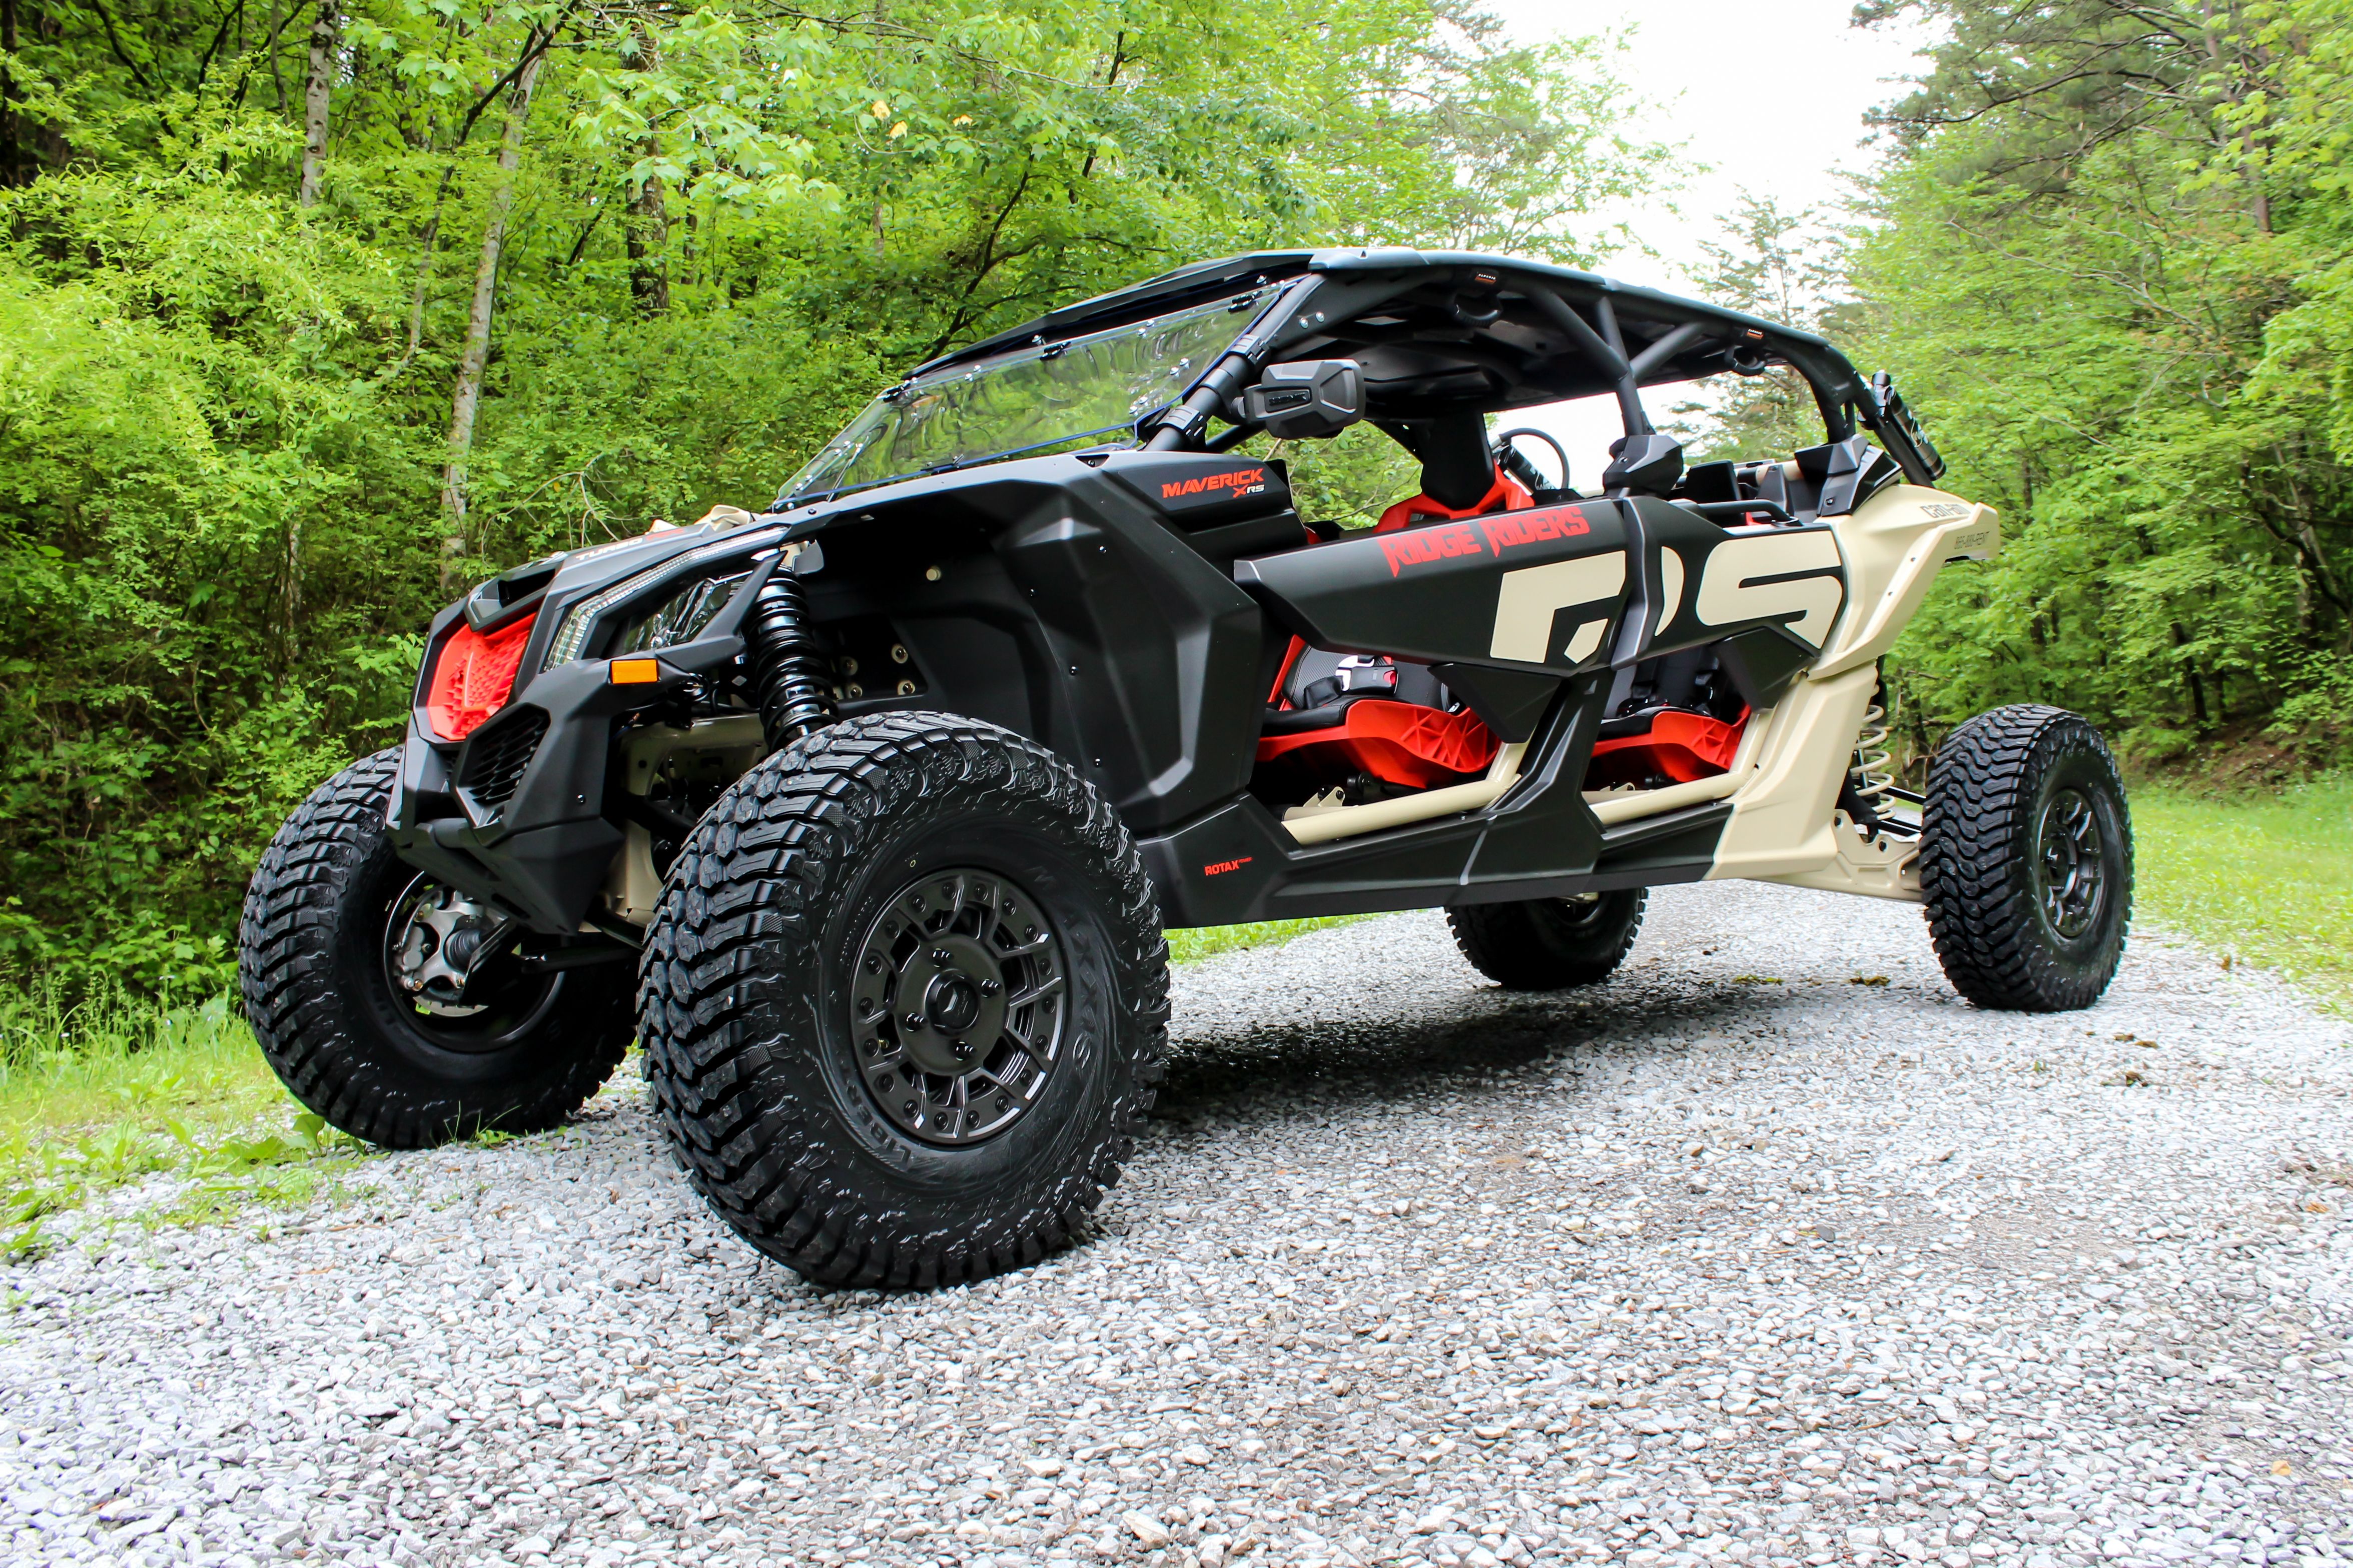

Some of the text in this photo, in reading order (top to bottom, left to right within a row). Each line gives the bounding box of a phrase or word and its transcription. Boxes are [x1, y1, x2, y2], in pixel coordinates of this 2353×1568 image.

[1161, 468, 1265, 498] MAVERICK
[575, 537, 643, 561] TURBO
[1376, 506, 1590, 578] RIDGE RIDERS
[1204, 860, 1240, 876] ROTAX
